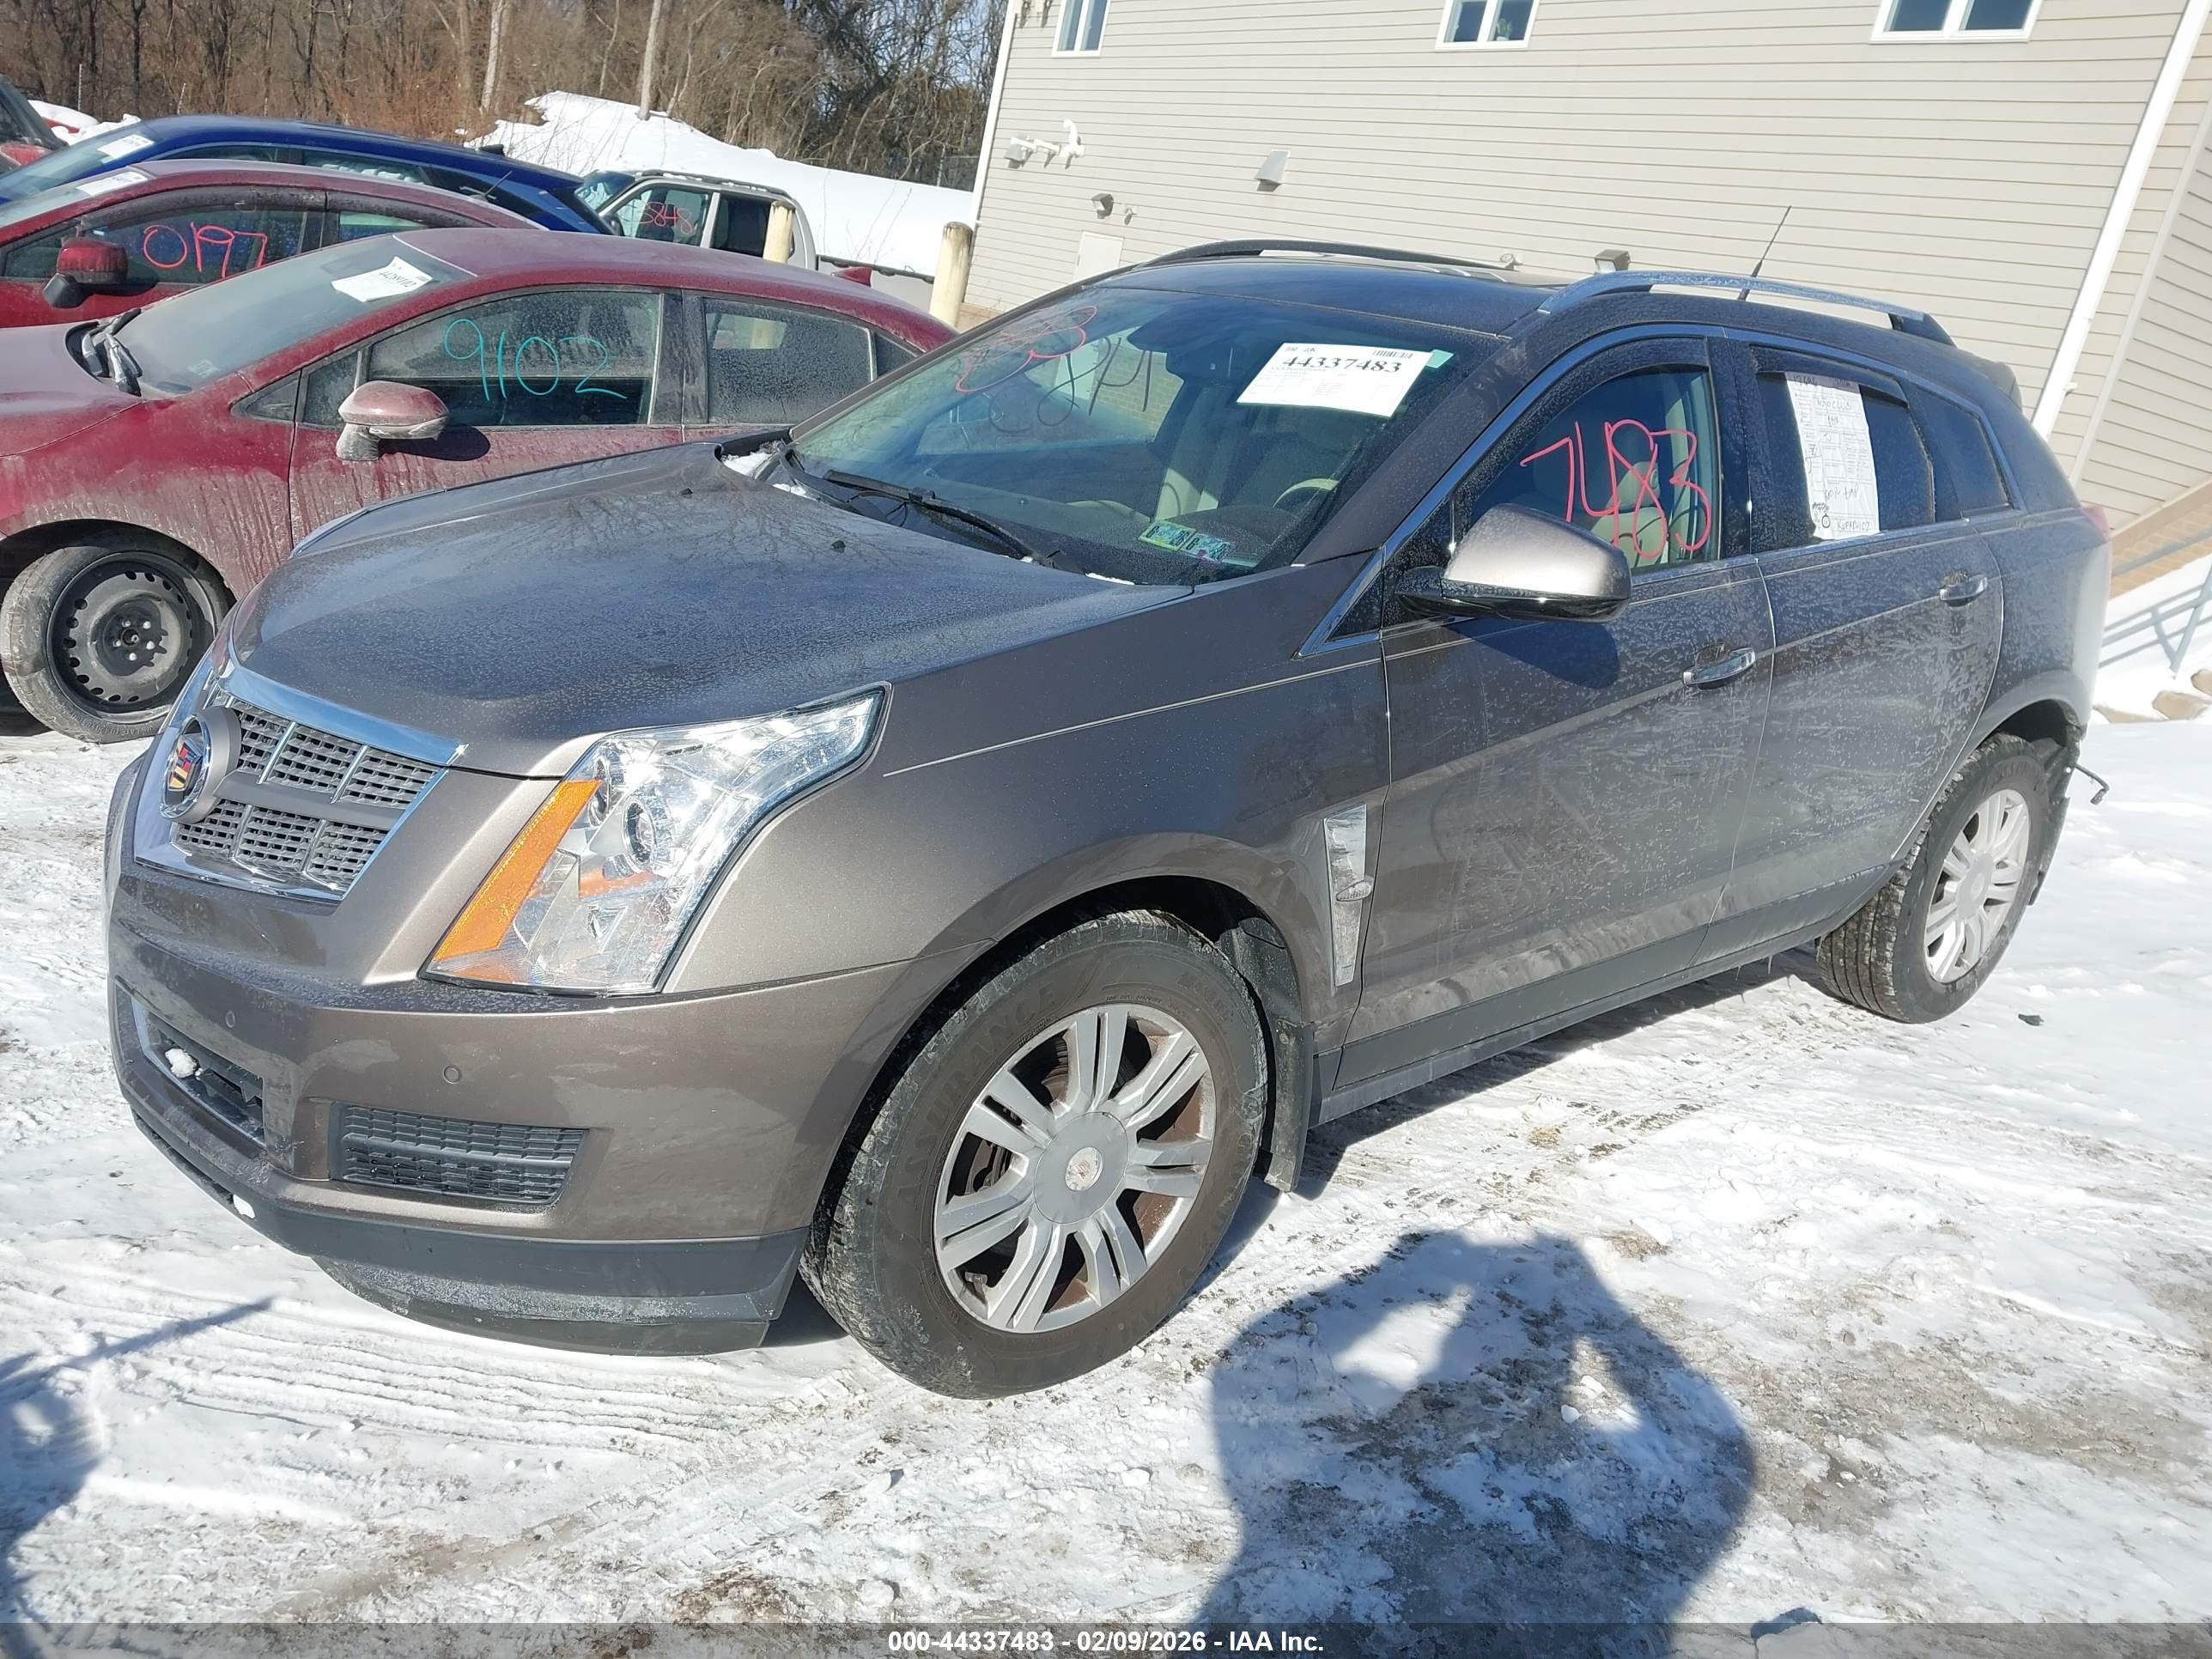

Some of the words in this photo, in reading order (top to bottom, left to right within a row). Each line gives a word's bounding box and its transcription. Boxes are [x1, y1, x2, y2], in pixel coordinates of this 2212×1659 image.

[143, 221, 269, 278] 0197
[444, 319, 627, 402] 9102
[1282, 356, 1402, 373] 44337483
[1520, 419, 1711, 559] 7483
